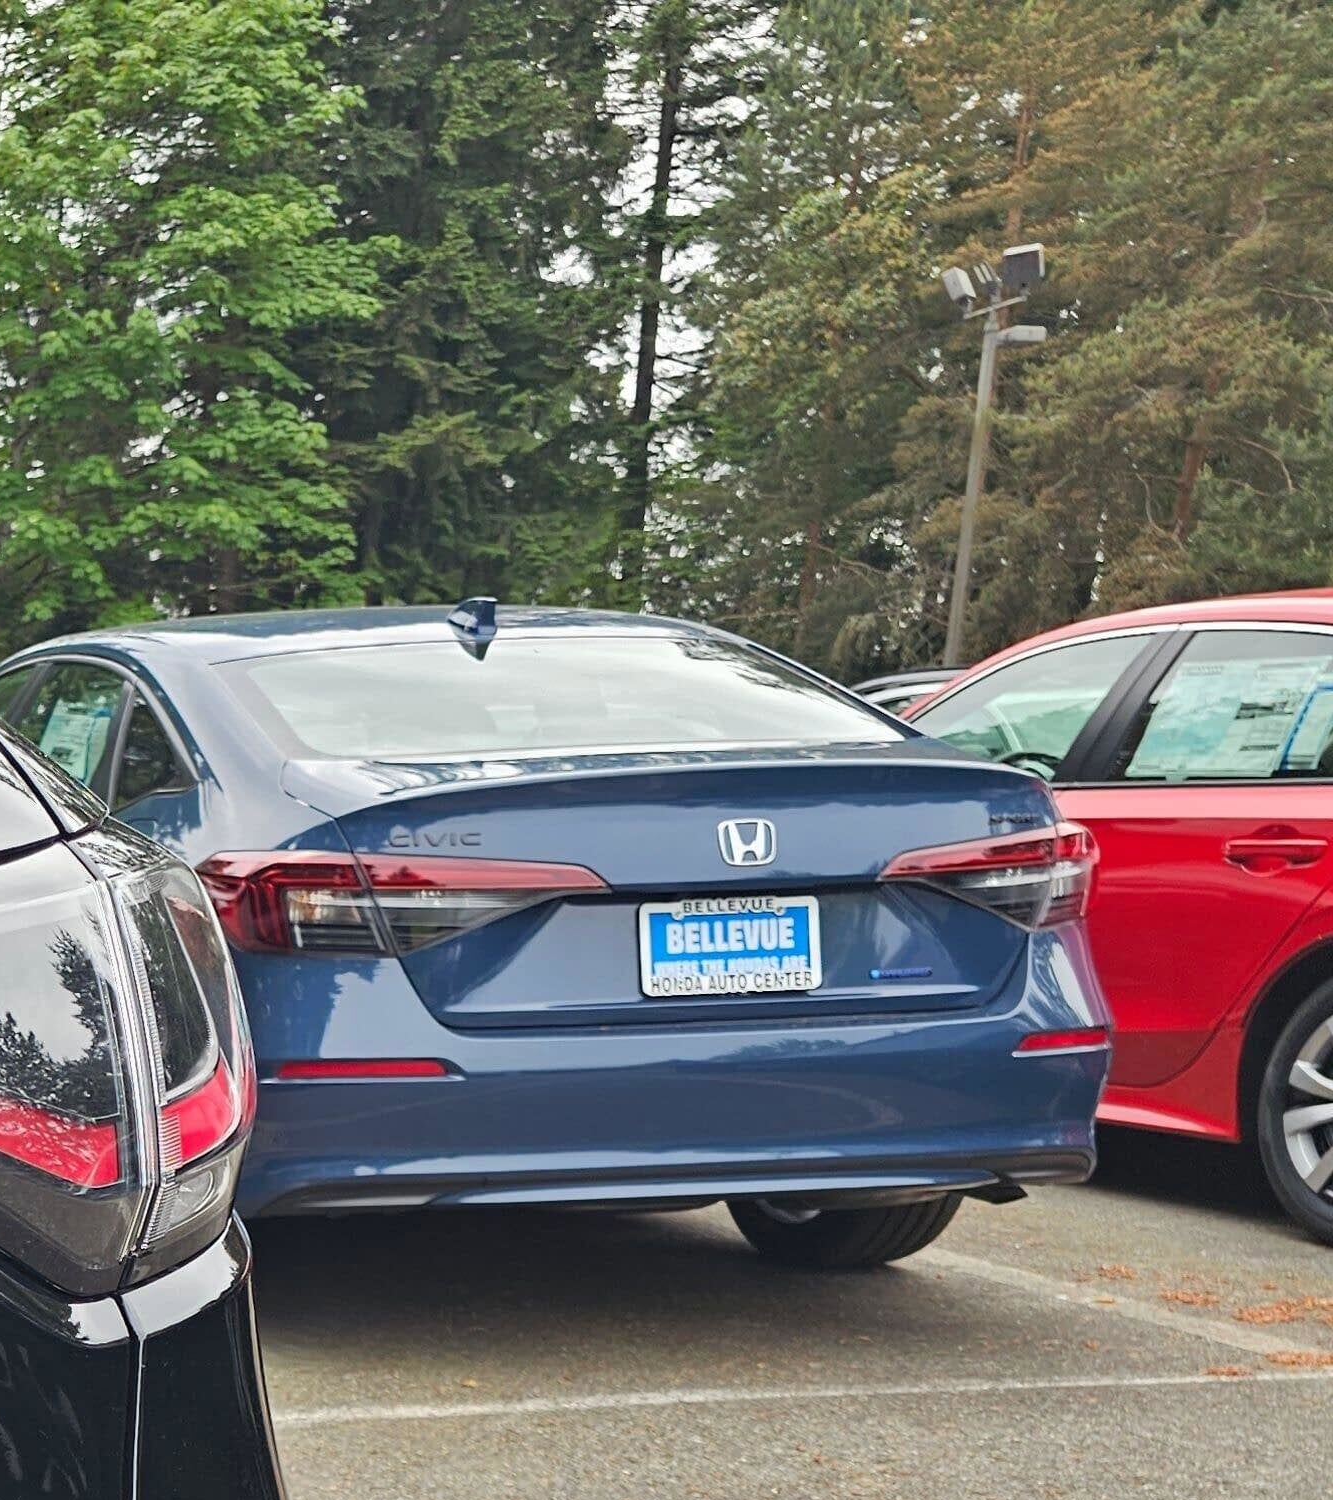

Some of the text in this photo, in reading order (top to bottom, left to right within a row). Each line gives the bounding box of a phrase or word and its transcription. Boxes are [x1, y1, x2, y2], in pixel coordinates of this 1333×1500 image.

[388, 832, 482, 848] CIVIC
[683, 898, 775, 913] BELLEVUE
[666, 917, 795, 955] BELLEVUE
[650, 971, 813, 993] HONDA AUTO CENTER
